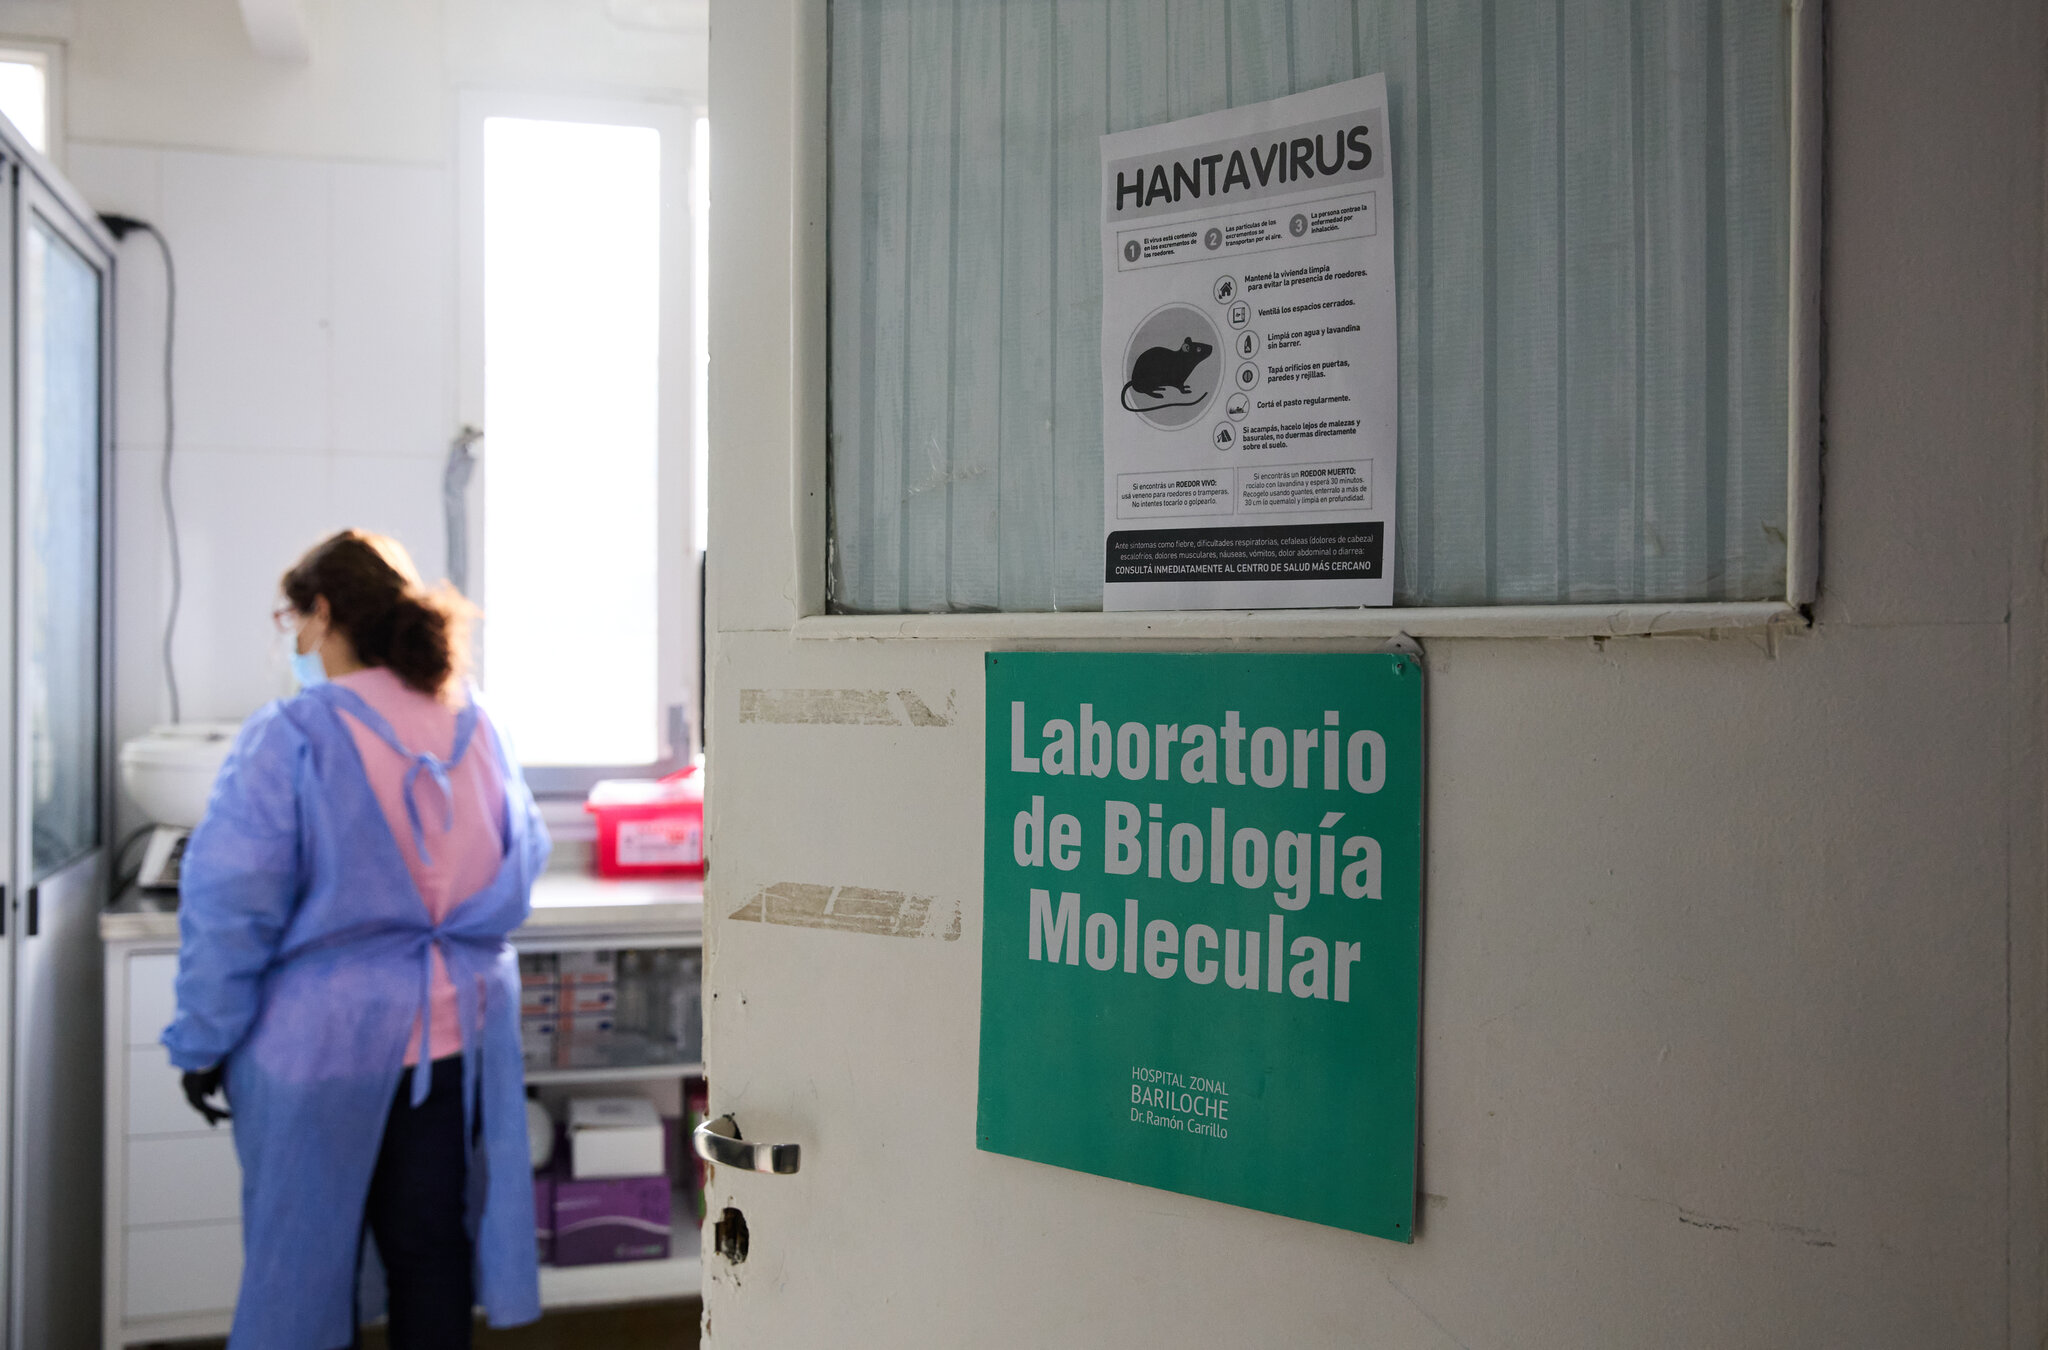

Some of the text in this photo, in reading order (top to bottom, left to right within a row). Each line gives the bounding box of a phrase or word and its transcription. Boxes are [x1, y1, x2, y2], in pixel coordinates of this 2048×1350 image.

[1116, 125, 1373, 211] HANTAVIRUS
[1318, 210, 1340, 219] persona
[1340, 206, 1361, 214] contrae
[1295, 219, 1303, 233] 3
[1311, 216, 1343, 226] enfermedad
[1174, 232, 1197, 240] contenido
[1210, 232, 1217, 246] 2
[1225, 230, 1258, 239] excrementos
[1159, 240, 1190, 249] excrementos
[1225, 238, 1254, 246] transportan
[1130, 245, 1135, 258] 1
[1152, 249, 1175, 257] roedores.
[1245, 265, 1330, 283] Mantené la vivienda limpia
[1248, 269, 1368, 292] para evitar la presencia de roedores.
[1258, 298, 1356, 316] Ventilá los espacios cerrados.
[1267, 331, 1290, 342] Limpiá
[1291, 330, 1303, 339] con
[1304, 328, 1320, 338] agua
[1326, 324, 1361, 334] lavandina
[1267, 340, 1302, 349] sin barrer.
[1268, 365, 1283, 375] Tapá
[1284, 363, 1311, 373] orificios
[1321, 360, 1350, 370] puertas,
[1267, 373, 1294, 384] paredes
[1301, 370, 1326, 381] rejillas.
[1257, 394, 1351, 409] Cortá el pasto regularmente.
[1243, 426, 1249, 434] Si
[1250, 425, 1280, 434] acampás,
[1280, 422, 1302, 431] hacelo
[1303, 421, 1318, 430] lejos
[1328, 419, 1355, 428] malezas
[1243, 433, 1275, 442] basurales,
[1285, 430, 1314, 439] duermas
[1314, 427, 1357, 437] directamente
[1243, 442, 1261, 451] sobre
[1269, 441, 1288, 449] suelo.
[1300, 469, 1326, 477] ROEDOR
[1327, 467, 1356, 476] MUERTO:
[1139, 481, 1167, 490] encontrás
[1176, 480, 1200, 488] ROEDOR
[1201, 479, 1217, 487] VIVO:
[1310, 478, 1329, 486] esperá
[1243, 490, 1269, 498] Recogelo
[1291, 489, 1314, 497] guantes,
[1328, 494, 1365, 503] profundidad.
[1163, 499, 1183, 507] tocarlo
[1189, 497, 1217, 507] golpearlo.
[1175, 540, 1196, 548] fiebre,
[1197, 539, 1233, 547] dificultades
[1235, 538, 1279, 548] respiratorias,
[1280, 537, 1308, 545] cefaleas
[1309, 536, 1336, 544] (dolores
[1347, 534, 1374, 543] cabeza)
[1179, 551, 1218, 559] musculares,
[1219, 550, 1248, 559] náuseas,
[1249, 549, 1277, 558] vómitos,
[1278, 549, 1295, 557] dolor
[1297, 548, 1331, 556] abdominal
[1338, 547, 1365, 555] diarrea:
[1115, 559, 1371, 574] CONSULTÁ INMEDIATAMENTE AL CENTRO DE SALUD MÁS CERCANO
[1010, 700, 1387, 795] Laboratorio
[1013, 795, 1384, 912] de Biología
[1027, 887, 1362, 1003] Molecular
[1132, 1066, 1229, 1096] HOSPITAL ZONAL
[1131, 1084, 1229, 1120] BARILOCHE
[1130, 1107, 1228, 1139] Dr. Ramón Carrillo
